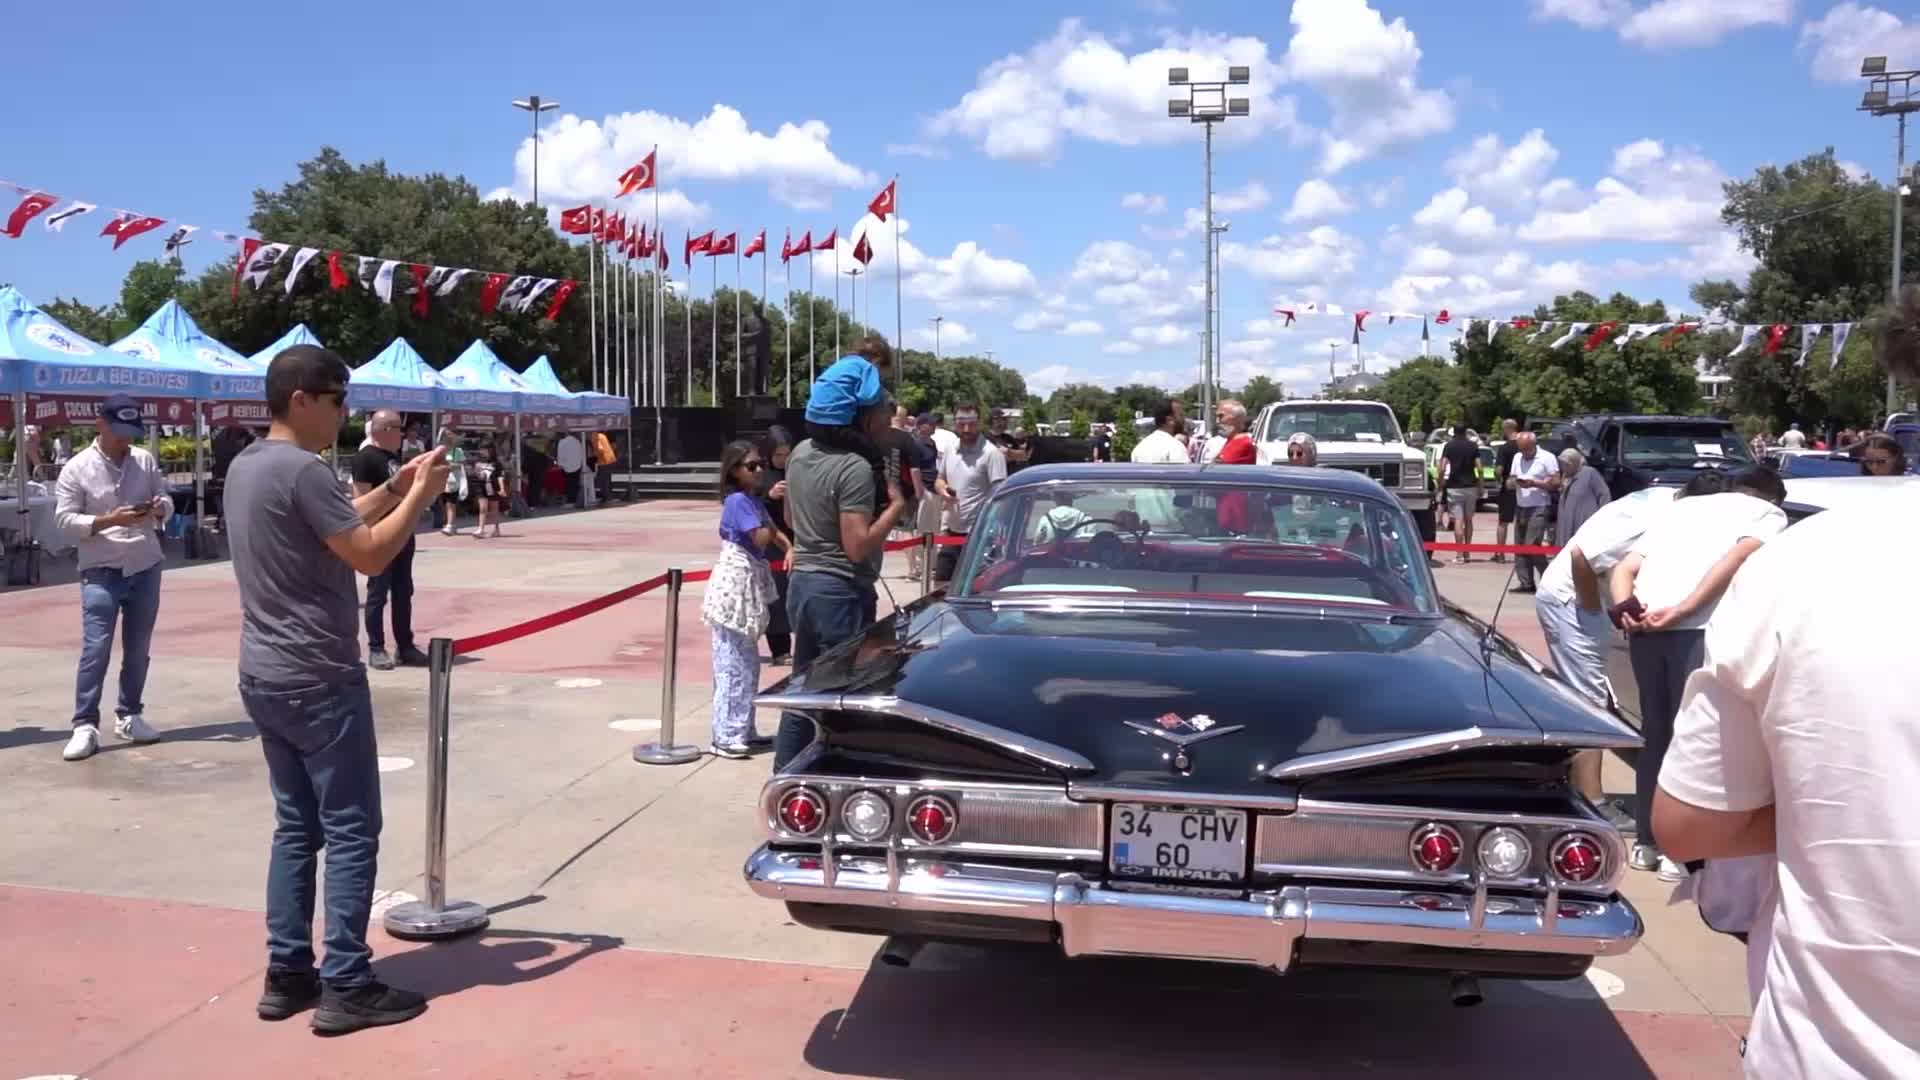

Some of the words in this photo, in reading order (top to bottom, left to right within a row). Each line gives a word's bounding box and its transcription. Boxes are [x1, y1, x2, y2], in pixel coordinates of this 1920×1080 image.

[59, 367, 106, 385] TUZLA
[1119, 811, 1152, 837] 34
[1180, 815, 1238, 842] CHV
[1155, 842, 1190, 868] 60
[1151, 867, 1232, 881] IMPALA
